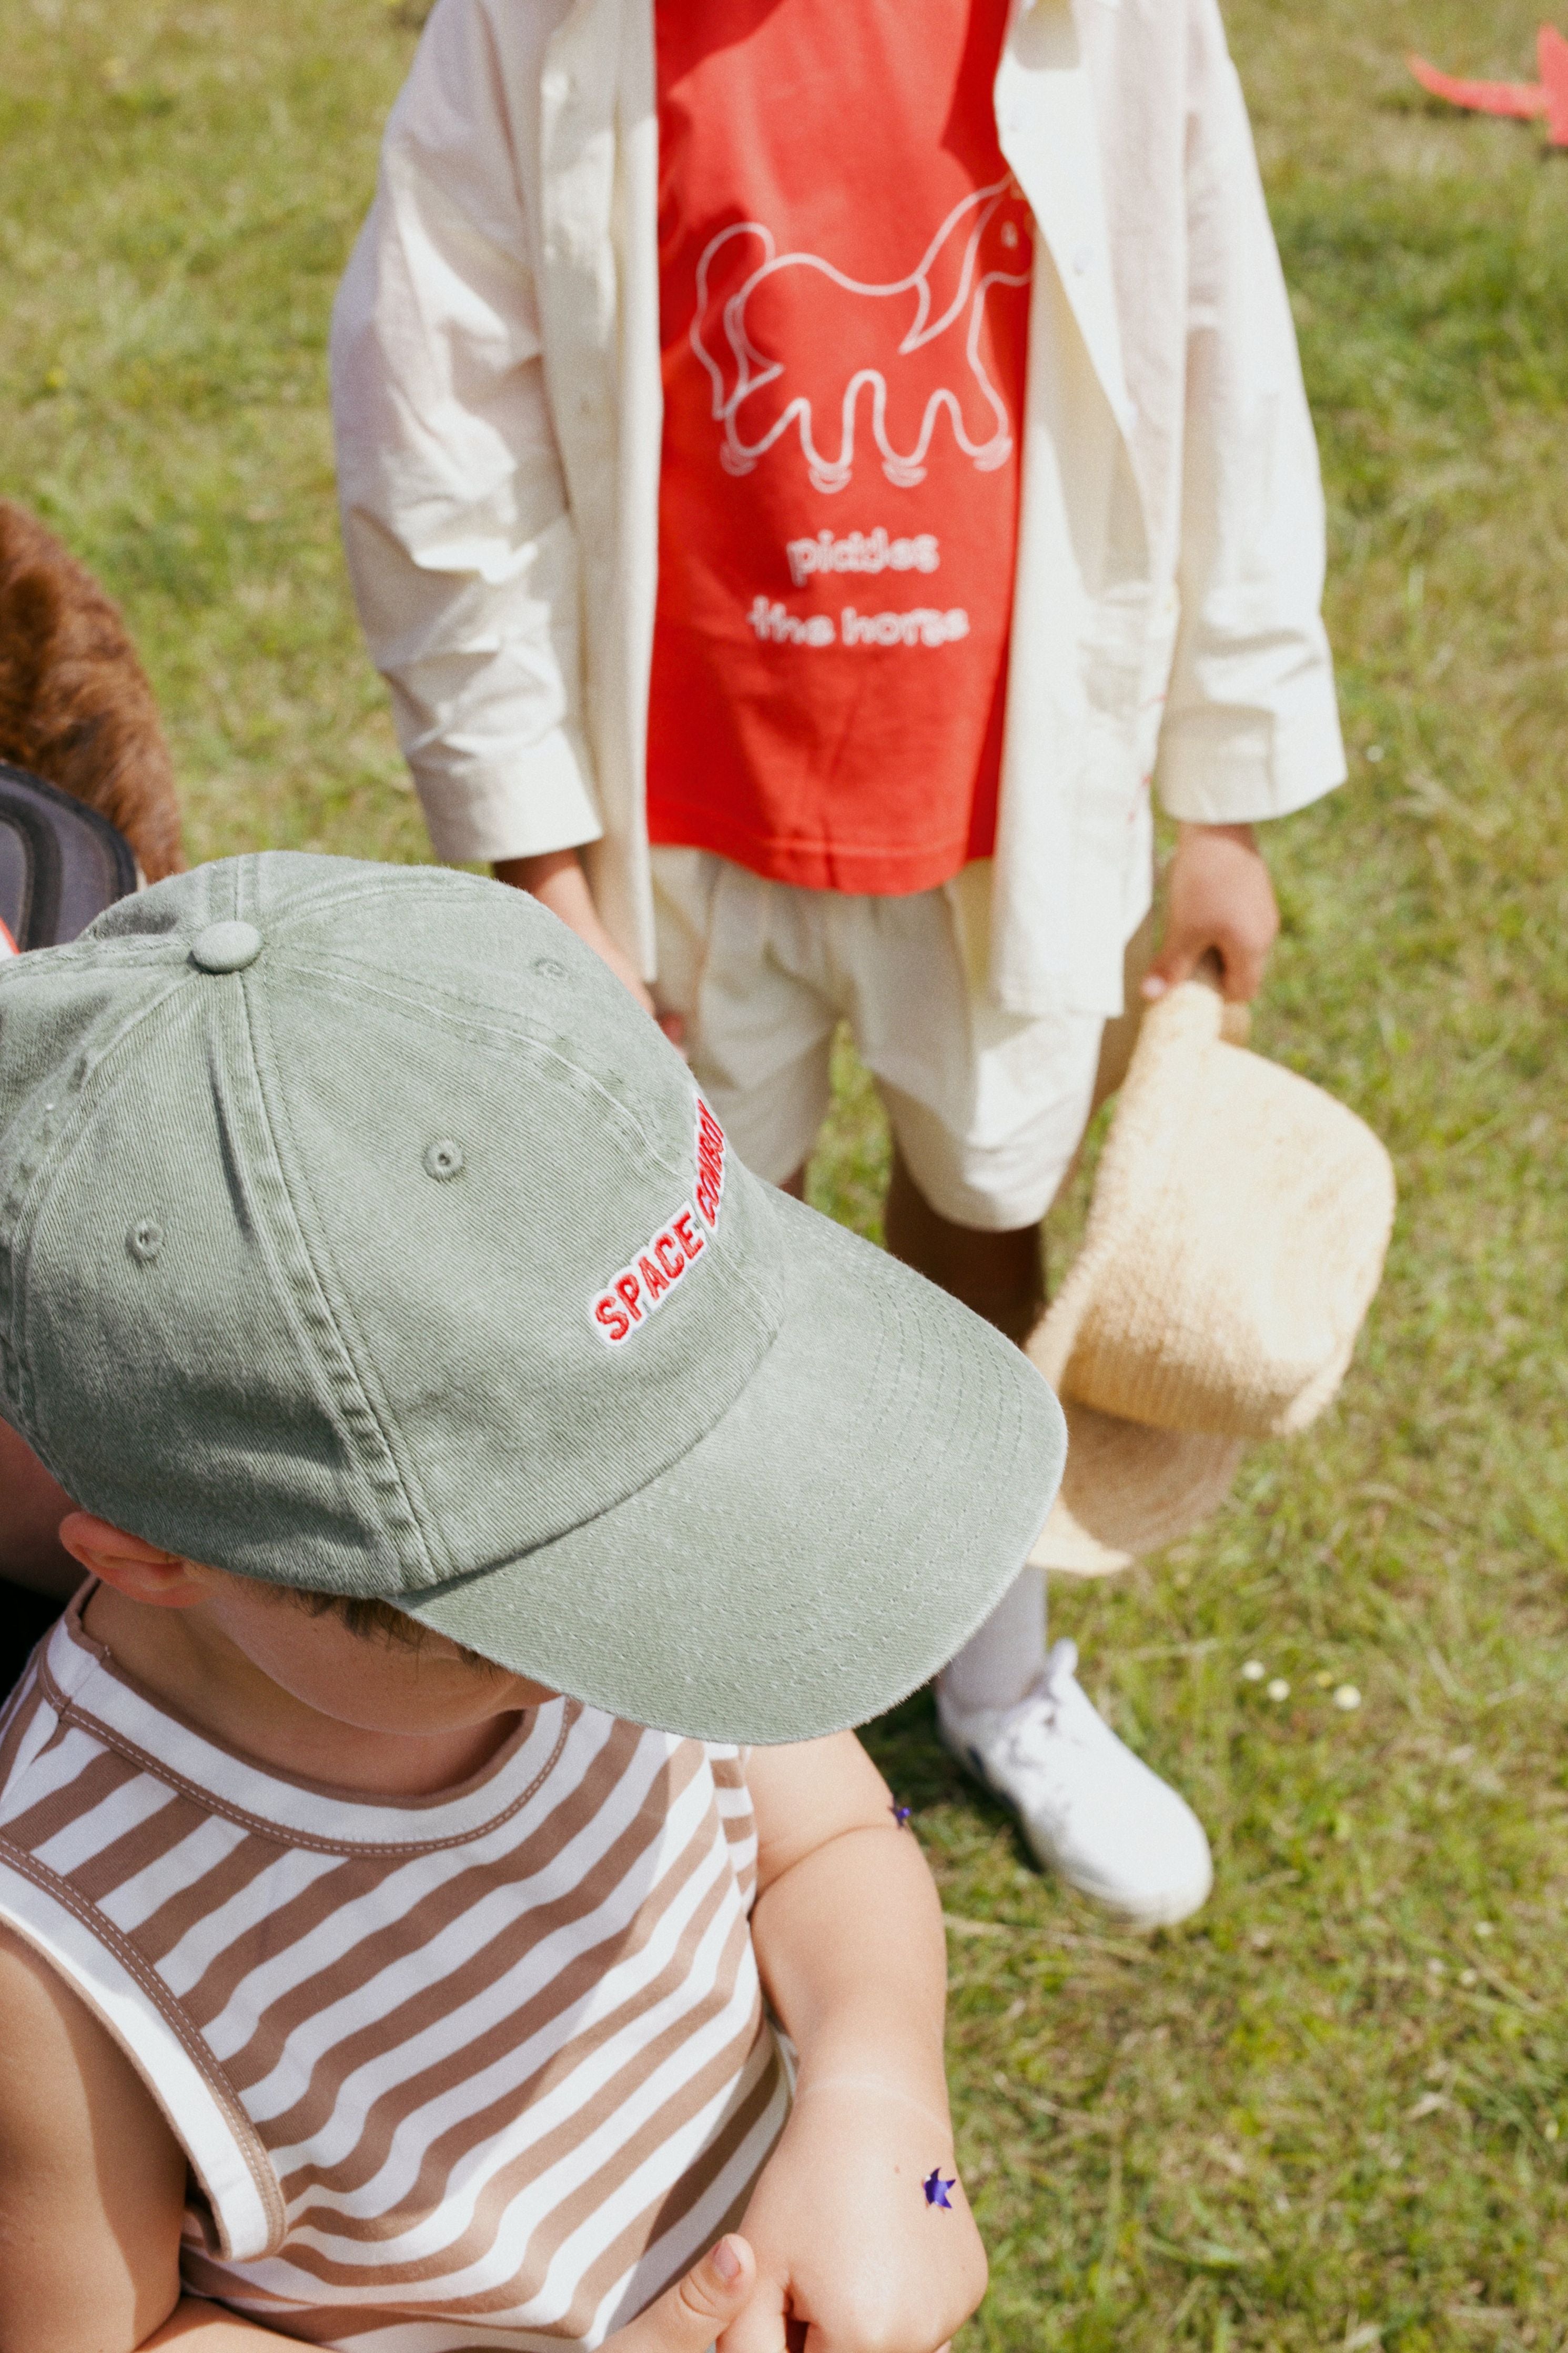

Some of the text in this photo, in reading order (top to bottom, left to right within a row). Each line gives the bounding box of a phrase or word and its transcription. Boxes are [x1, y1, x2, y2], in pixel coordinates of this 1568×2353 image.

[747, 595, 970, 647] the horse
[595, 1098, 724, 1341] SPACE COWBOY
